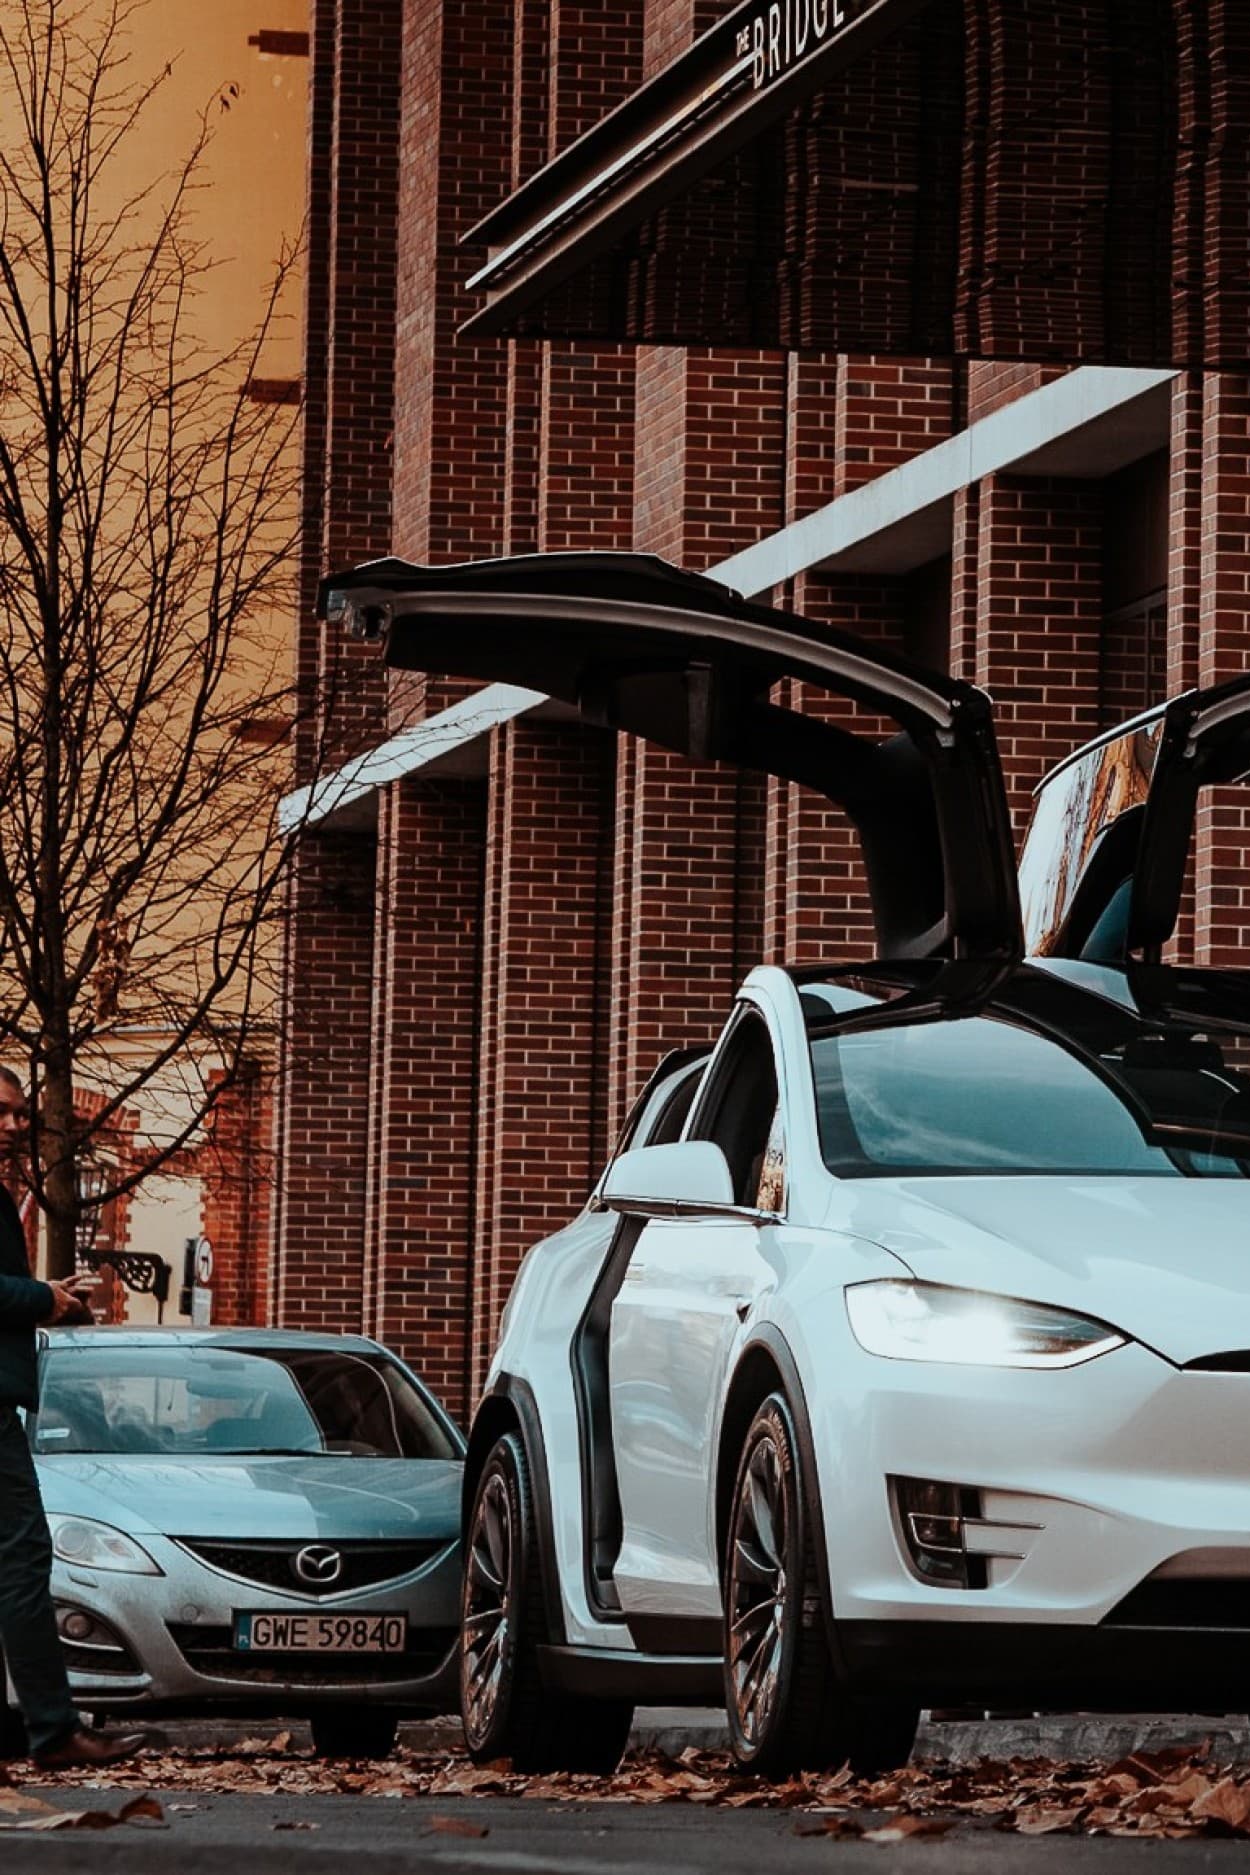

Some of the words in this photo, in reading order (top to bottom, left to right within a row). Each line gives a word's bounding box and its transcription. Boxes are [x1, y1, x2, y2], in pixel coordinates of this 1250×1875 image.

[736, 25, 750, 57] THE
[253, 1617, 308, 1647] GWE
[318, 1619, 401, 1649] 59840
